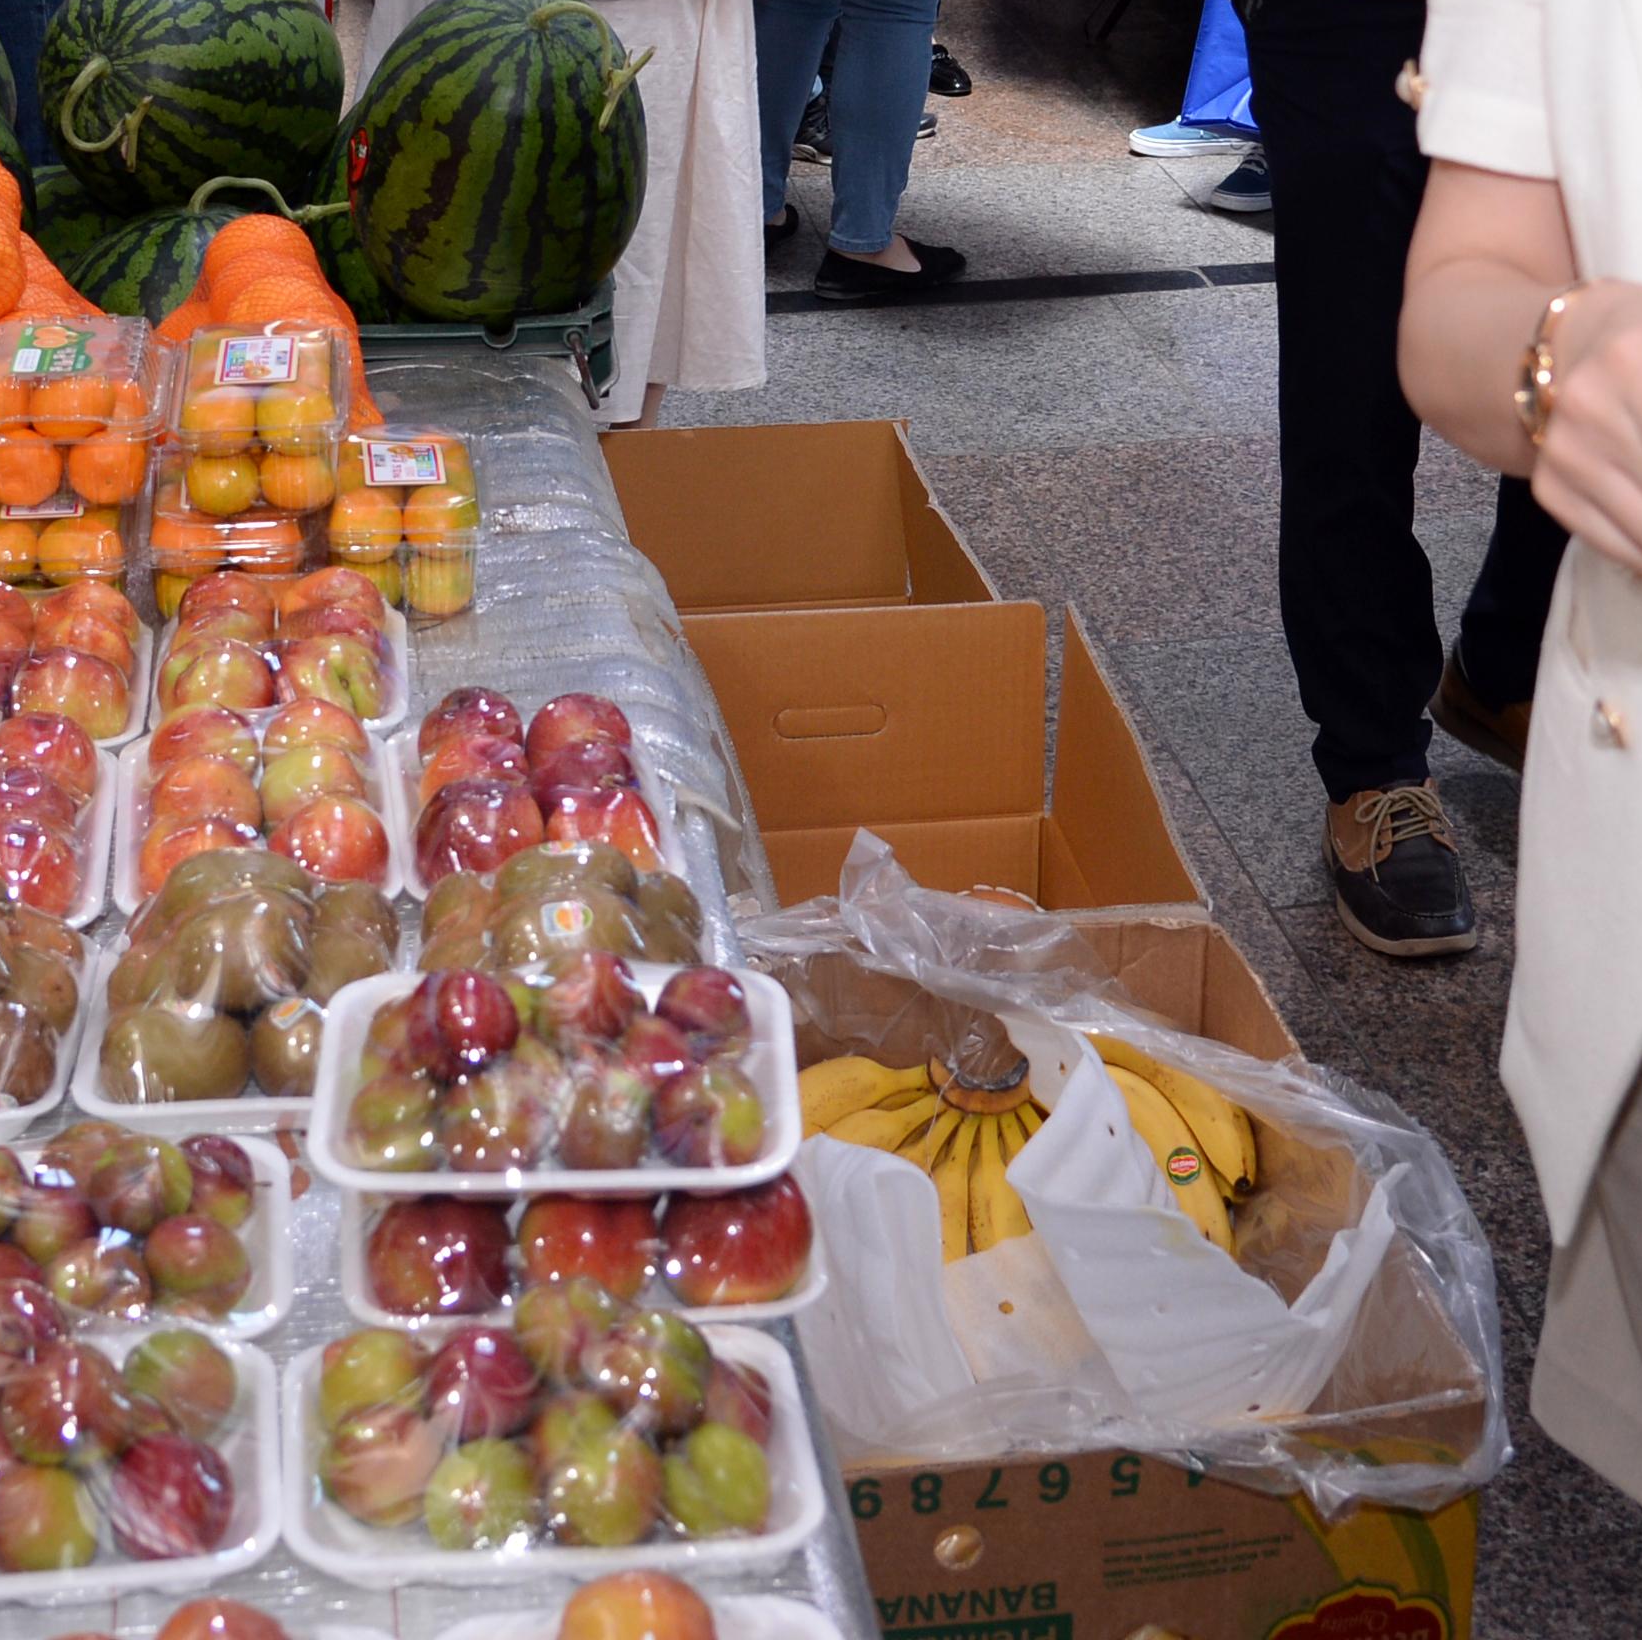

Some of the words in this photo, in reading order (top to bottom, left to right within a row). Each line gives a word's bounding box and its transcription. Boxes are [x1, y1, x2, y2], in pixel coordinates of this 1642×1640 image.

[849, 1476, 884, 1520] 9
[910, 1470, 944, 1514] 8
[974, 1467, 1009, 1510] 7
[1039, 1460, 1072, 1505] 6
[1111, 1456, 1143, 1498] 5
[876, 1581, 1058, 1628] BANANA
